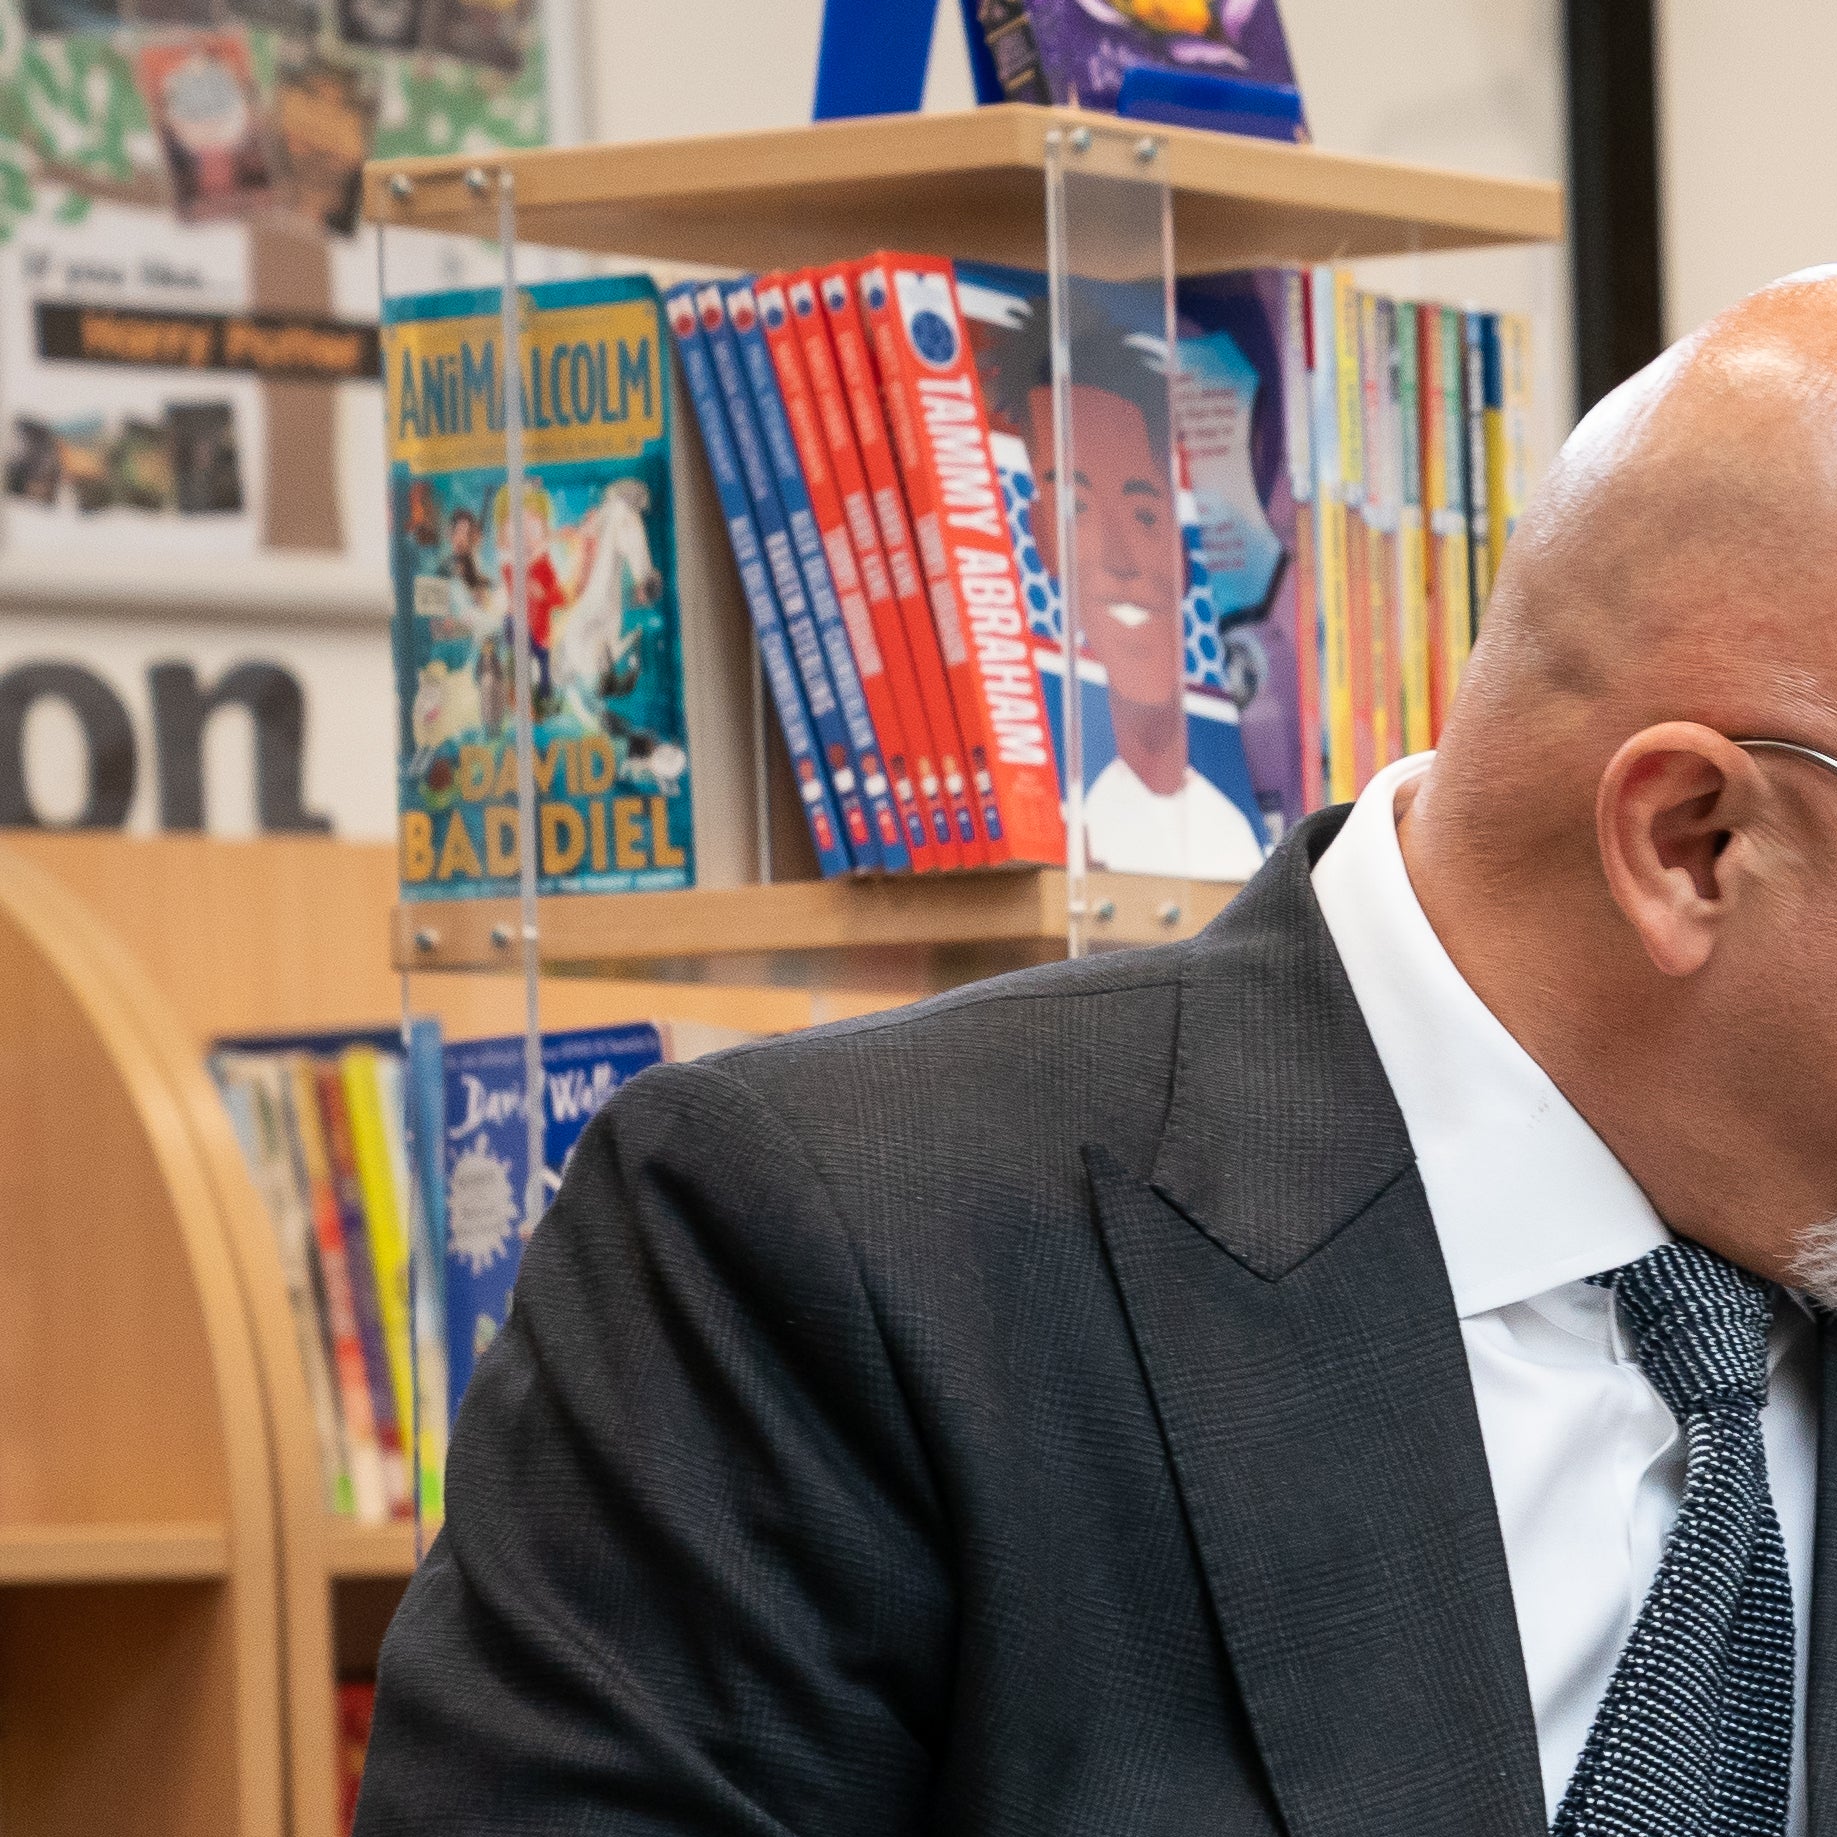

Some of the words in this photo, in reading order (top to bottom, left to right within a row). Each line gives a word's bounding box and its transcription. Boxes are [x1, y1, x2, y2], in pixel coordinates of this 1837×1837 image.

[918, 376, 1003, 538] TAMMY
[953, 543, 1049, 767] ABRAHAM
[458, 737, 616, 802] DAVID
[402, 795, 685, 882] BADDIEL
